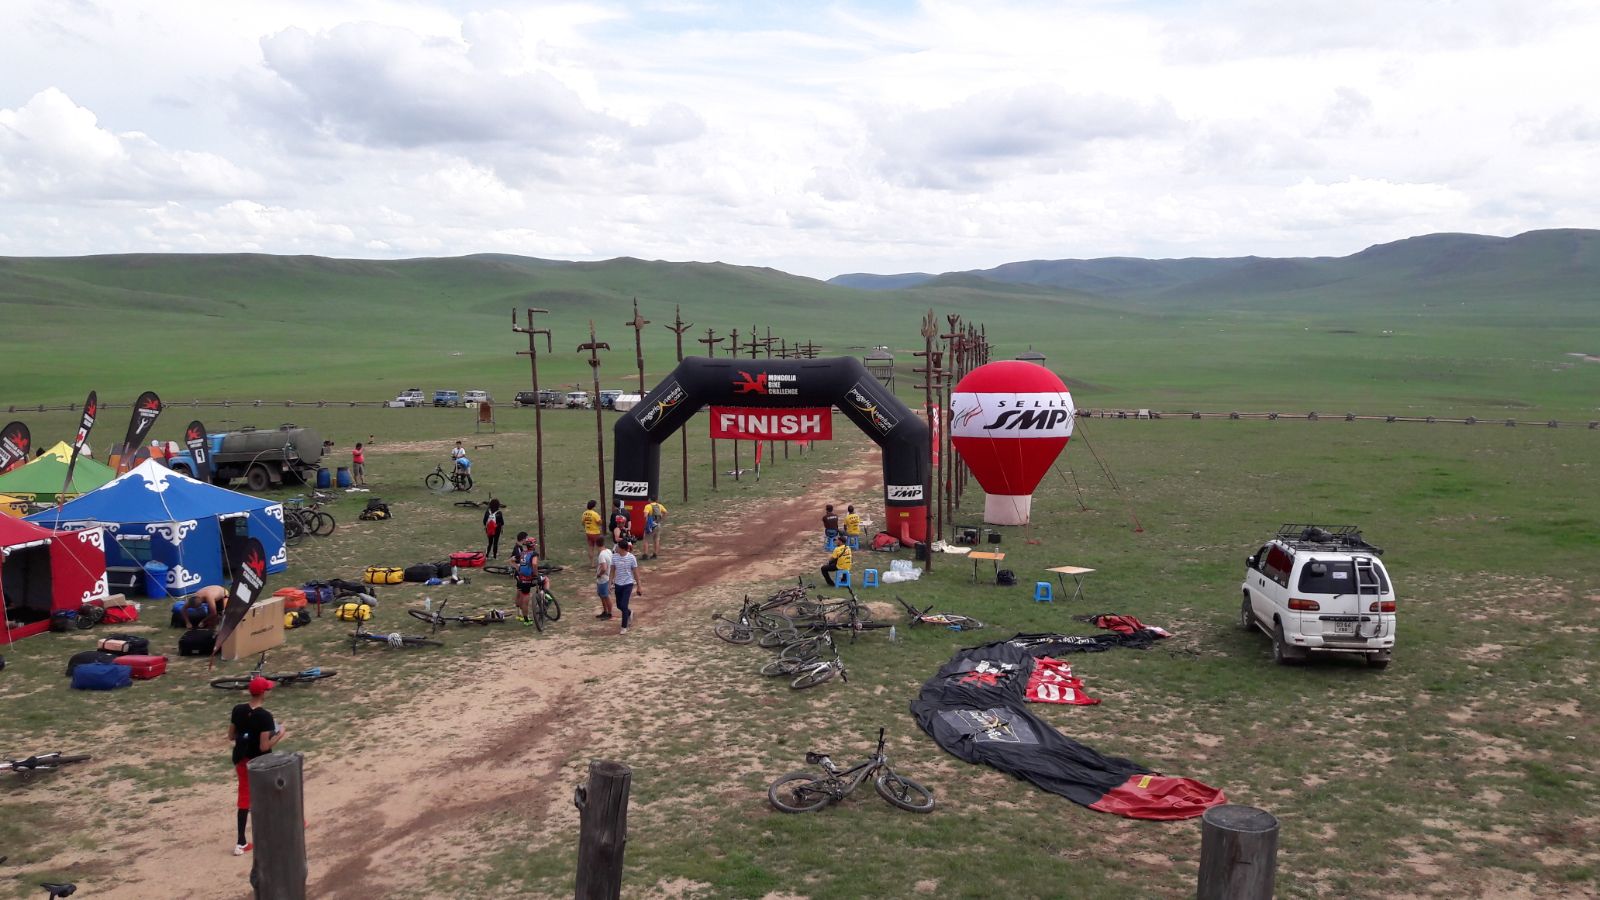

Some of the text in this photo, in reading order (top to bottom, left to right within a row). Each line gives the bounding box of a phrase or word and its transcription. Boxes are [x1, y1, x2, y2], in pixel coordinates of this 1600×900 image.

[997, 399, 1066, 408] SELLE
[720, 413, 822, 434] FINISH
[983, 409, 1068, 430] SMP
[618, 485, 647, 493] SMP
[891, 489, 922, 497] SMP
